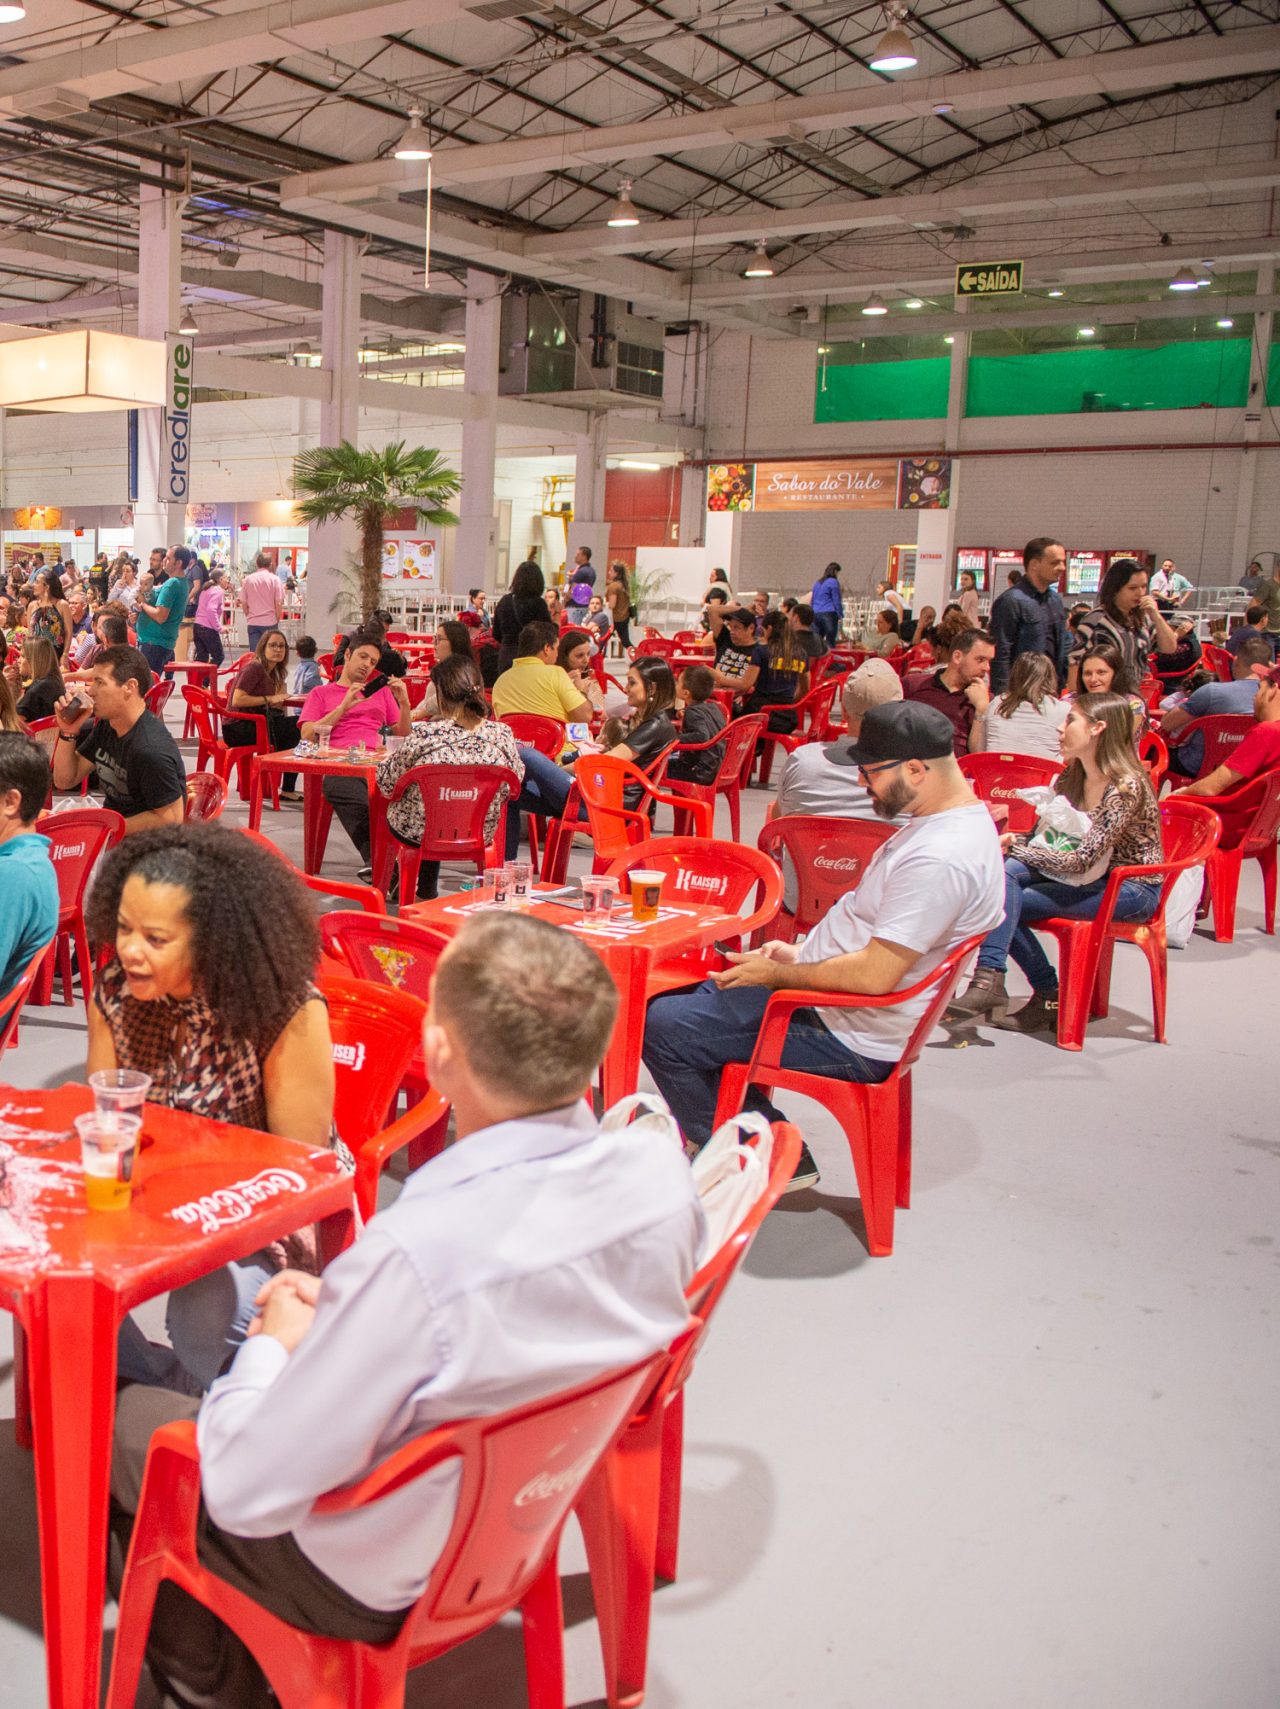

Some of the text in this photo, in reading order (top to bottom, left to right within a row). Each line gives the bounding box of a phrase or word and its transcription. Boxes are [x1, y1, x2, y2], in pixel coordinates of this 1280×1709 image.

[977, 266, 1018, 291] SAÍDA
[168, 344, 191, 497] crediare
[767, 472, 817, 491] Sabor
[837, 472, 883, 490] Vale
[813, 855, 859, 871] Coca-Cola
[171, 1167, 308, 1234] Coca-Cola
